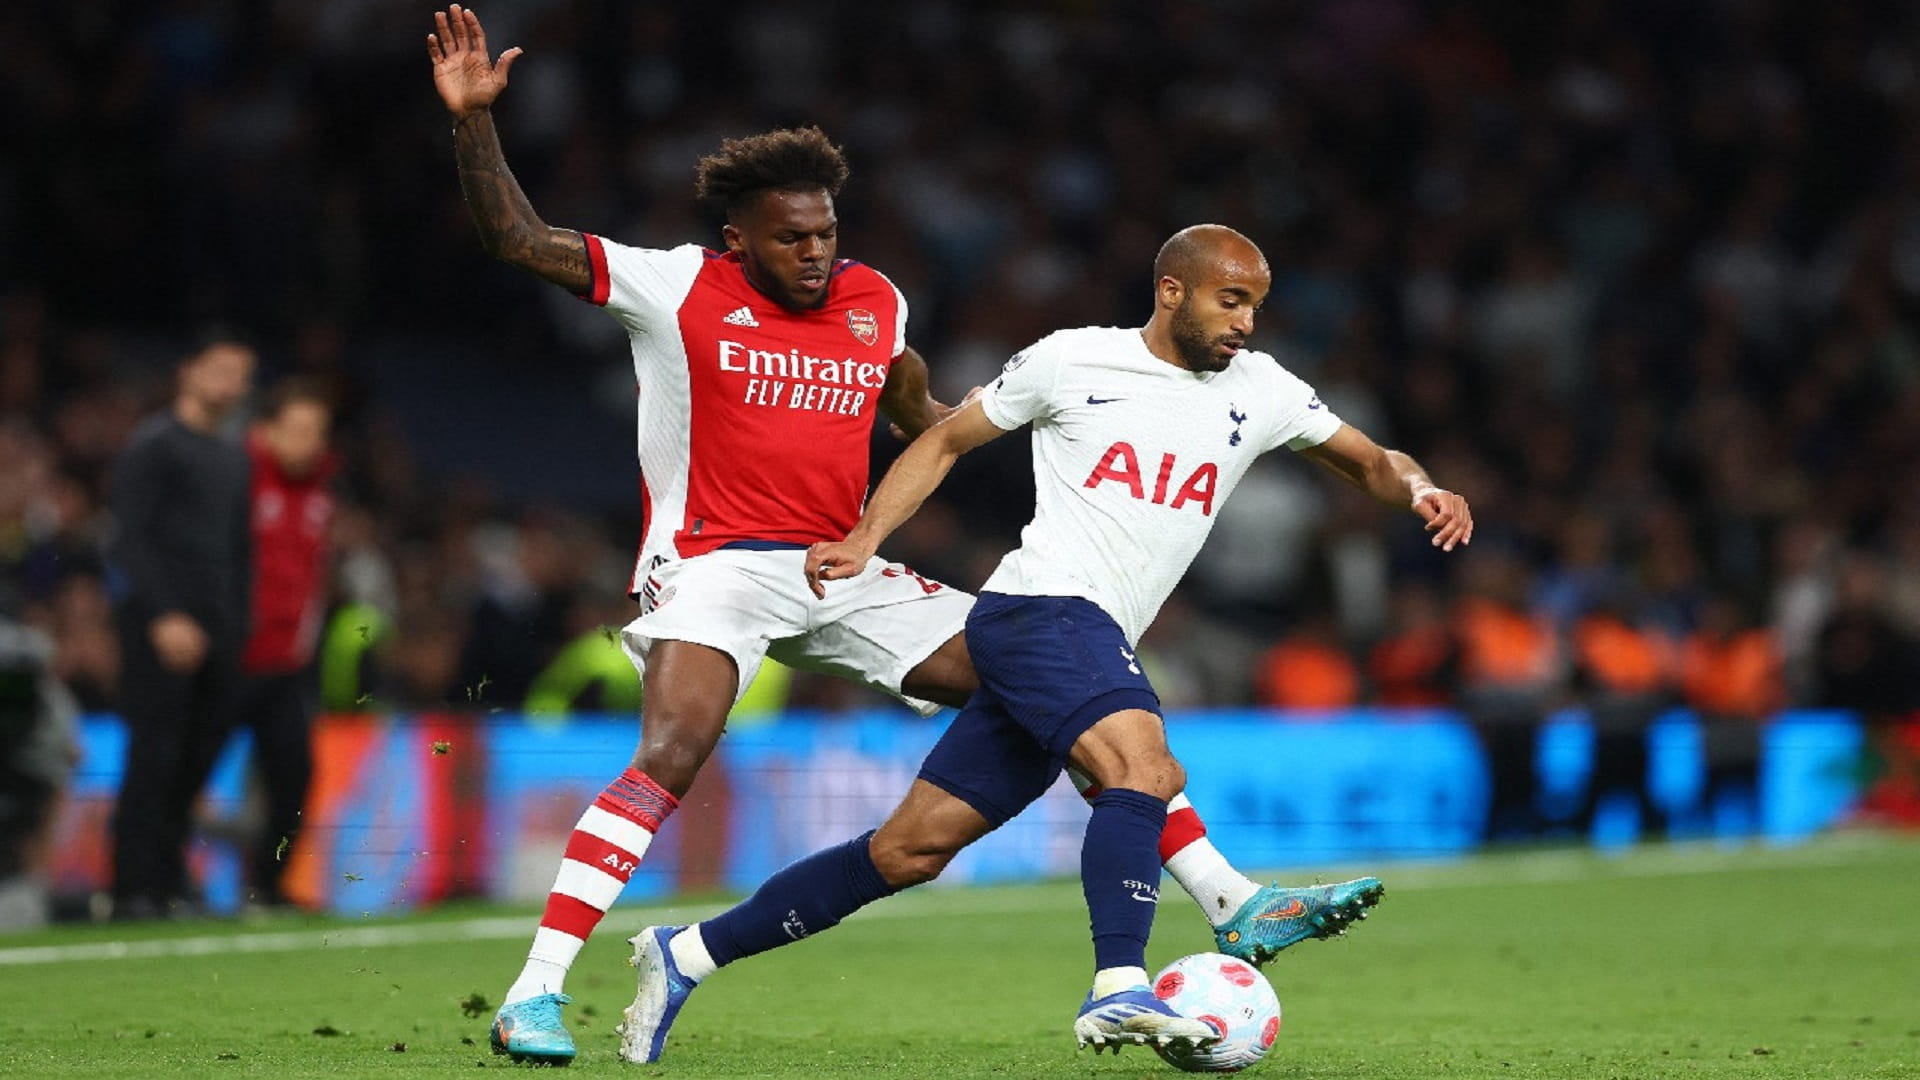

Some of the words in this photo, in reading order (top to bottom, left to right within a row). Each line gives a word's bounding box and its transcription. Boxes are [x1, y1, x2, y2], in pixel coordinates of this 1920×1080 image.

[718, 340, 888, 388] Emirates
[744, 379, 784, 407] FLY
[789, 384, 865, 416] BETTER
[1083, 441, 1217, 516] AIA
